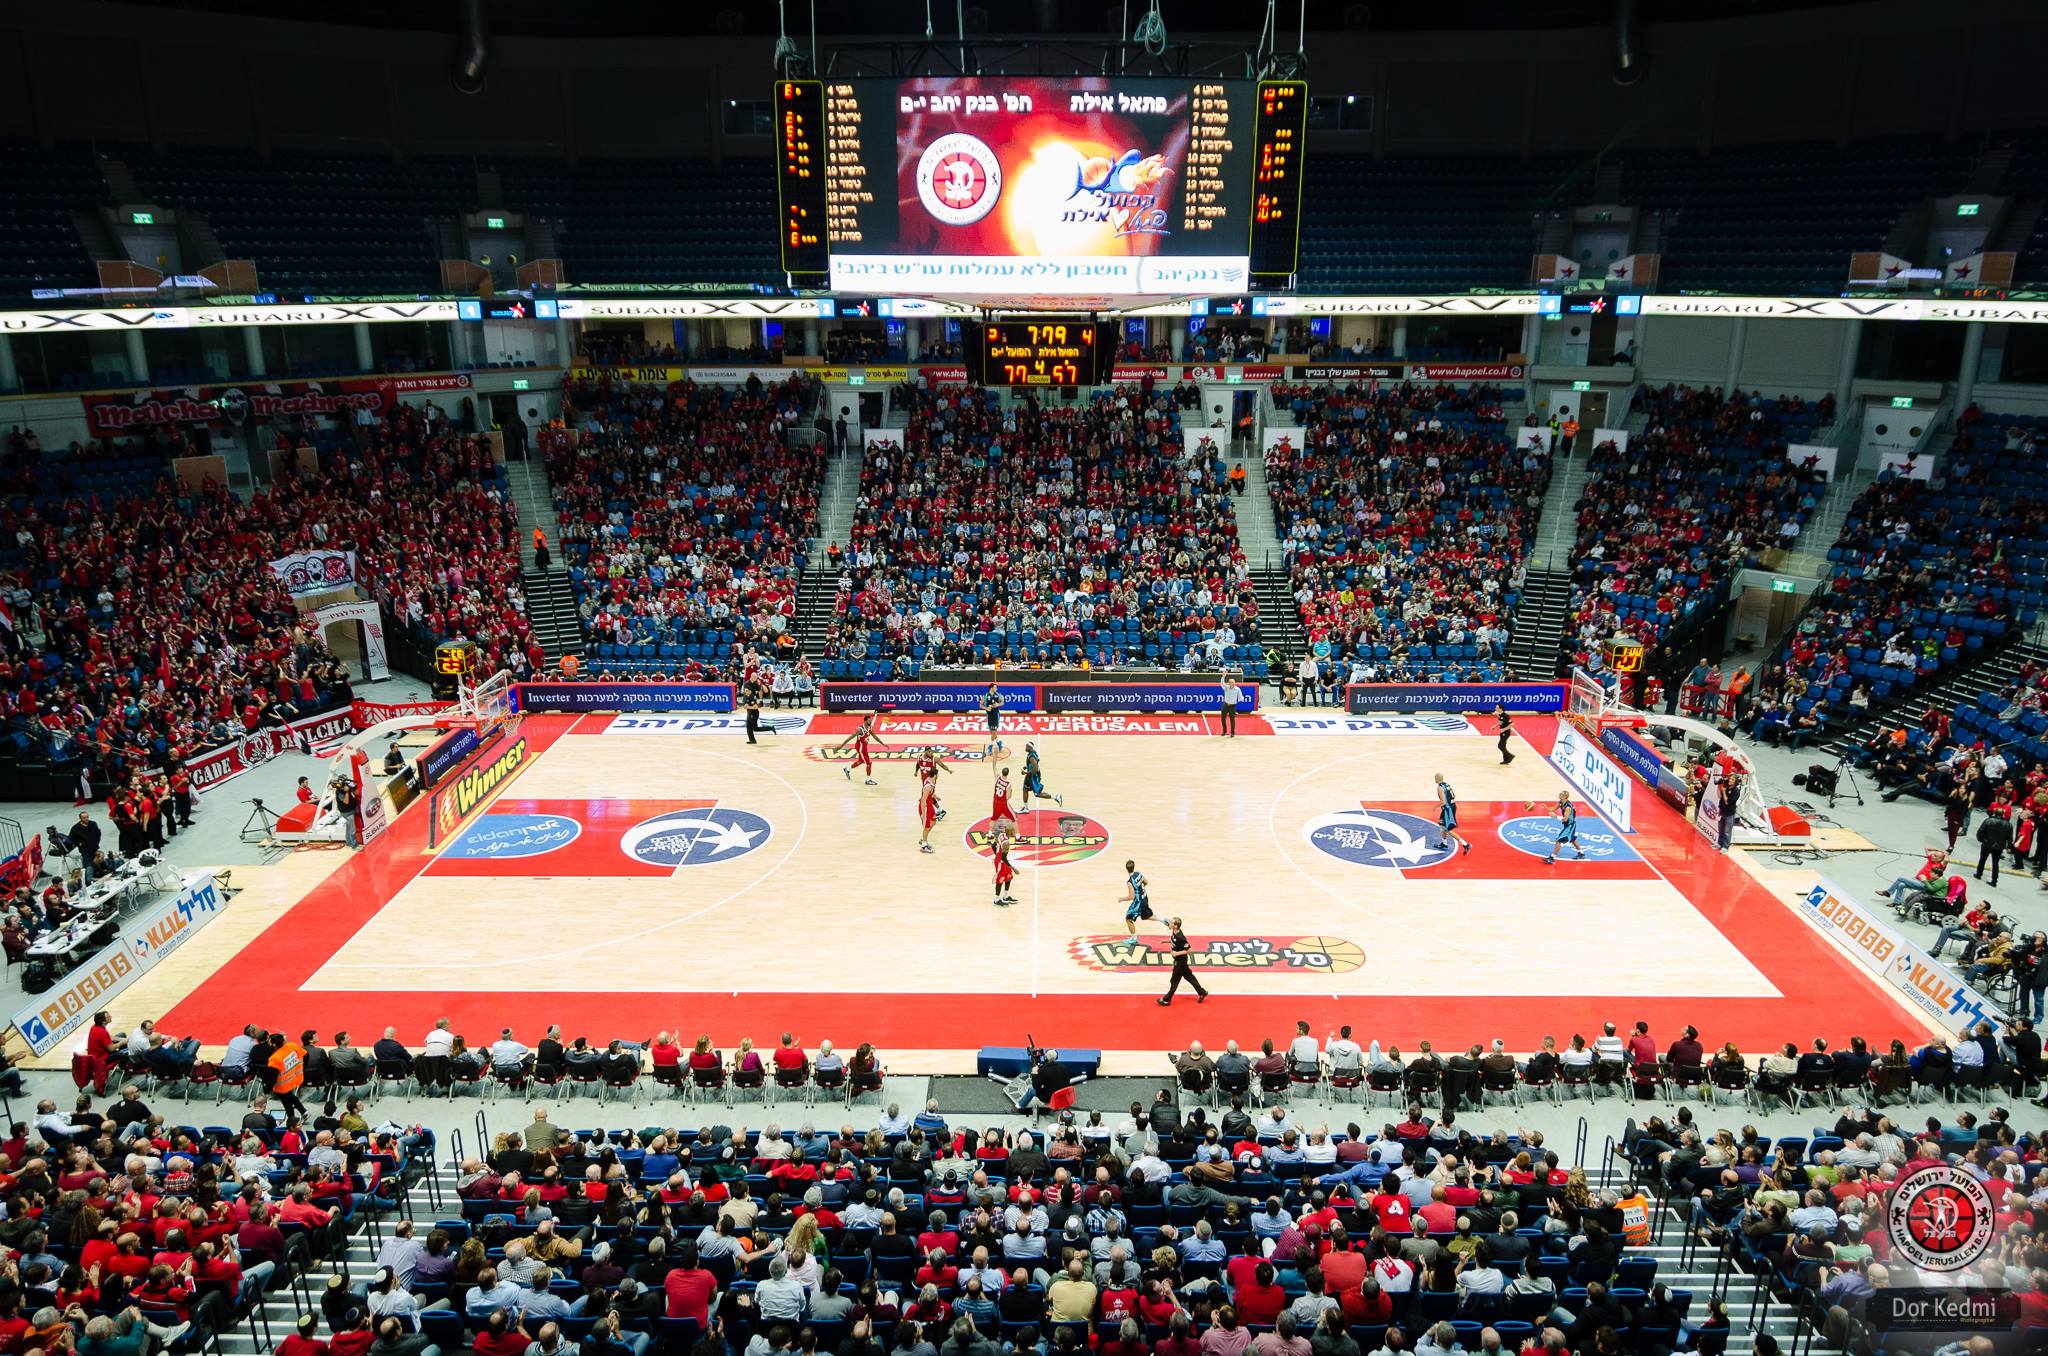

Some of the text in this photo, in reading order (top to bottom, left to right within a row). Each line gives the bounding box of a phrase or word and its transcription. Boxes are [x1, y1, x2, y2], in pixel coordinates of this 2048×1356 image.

[965, 95, 999, 115] בנק
[1070, 93, 1115, 113] אילת
[1187, 153, 1198, 164] 10
[827, 165, 838, 176] 10
[1187, 166, 1197, 176] 11
[827, 179, 837, 189] 11
[1186, 180, 1197, 190] 12
[1185, 193, 1197, 204] 14
[829, 218, 839, 228] 14
[1062, 211, 1111, 223] אילת
[949, 262, 1014, 276] עמלות
[1019, 262, 1060, 276] ללא
[1067, 262, 1127, 278] חשבון
[1186, 268, 1219, 281] בנק
[591, 306, 697, 315] SUBARU
[700, 302, 795, 314] XV
[1304, 303, 1412, 311] SUBARU
[1416, 298, 1512, 311] XV
[1656, 301, 1897, 315] SUBARU XV
[198, 305, 431, 323] SUBARU XV
[638, 368, 669, 381] צומת
[1152, 369, 1165, 377] club
[1429, 367, 1507, 378] www.hapoel.co.il
[416, 377, 457, 389] יציע אמיר
[528, 693, 571, 703] Inverter
[576, 692, 729, 705] החלפת מערכות הסקה למערכות
[830, 692, 873, 703] Inverter
[878, 692, 953, 705] הסקה למערכות
[1049, 693, 1092, 703] Inverter
[1097, 692, 1141, 703] למערכות
[1144, 694, 1172, 705] הסקה
[1175, 693, 1213, 703] מערכות
[1356, 693, 1399, 704] Inverter
[1405, 692, 1560, 706] החלפת מערכות הסקה למערכות
[613, 718, 748, 731] בנק יהב
[880, 721, 939, 732] PAIS
[1040, 721, 1200, 732] JERUSALEM
[1275, 718, 1418, 731] בנק יהב
[954, 750, 983, 760] סל
[1606, 730, 1659, 777] החלפת מערכות הסקה
[428, 750, 450, 775] Inverter
[456, 737, 527, 819] Winner
[1585, 750, 1624, 801] עיניים
[1582, 773, 1624, 824] ד"ר לוינגר
[177, 883, 217, 923] קליל
[146, 911, 187, 950] KLIL
[1210, 939, 1271, 954] ליגת
[1280, 950, 1332, 967] סל
[1908, 962, 1955, 1009] KLIL
[1950, 988, 2000, 1034] קליל
